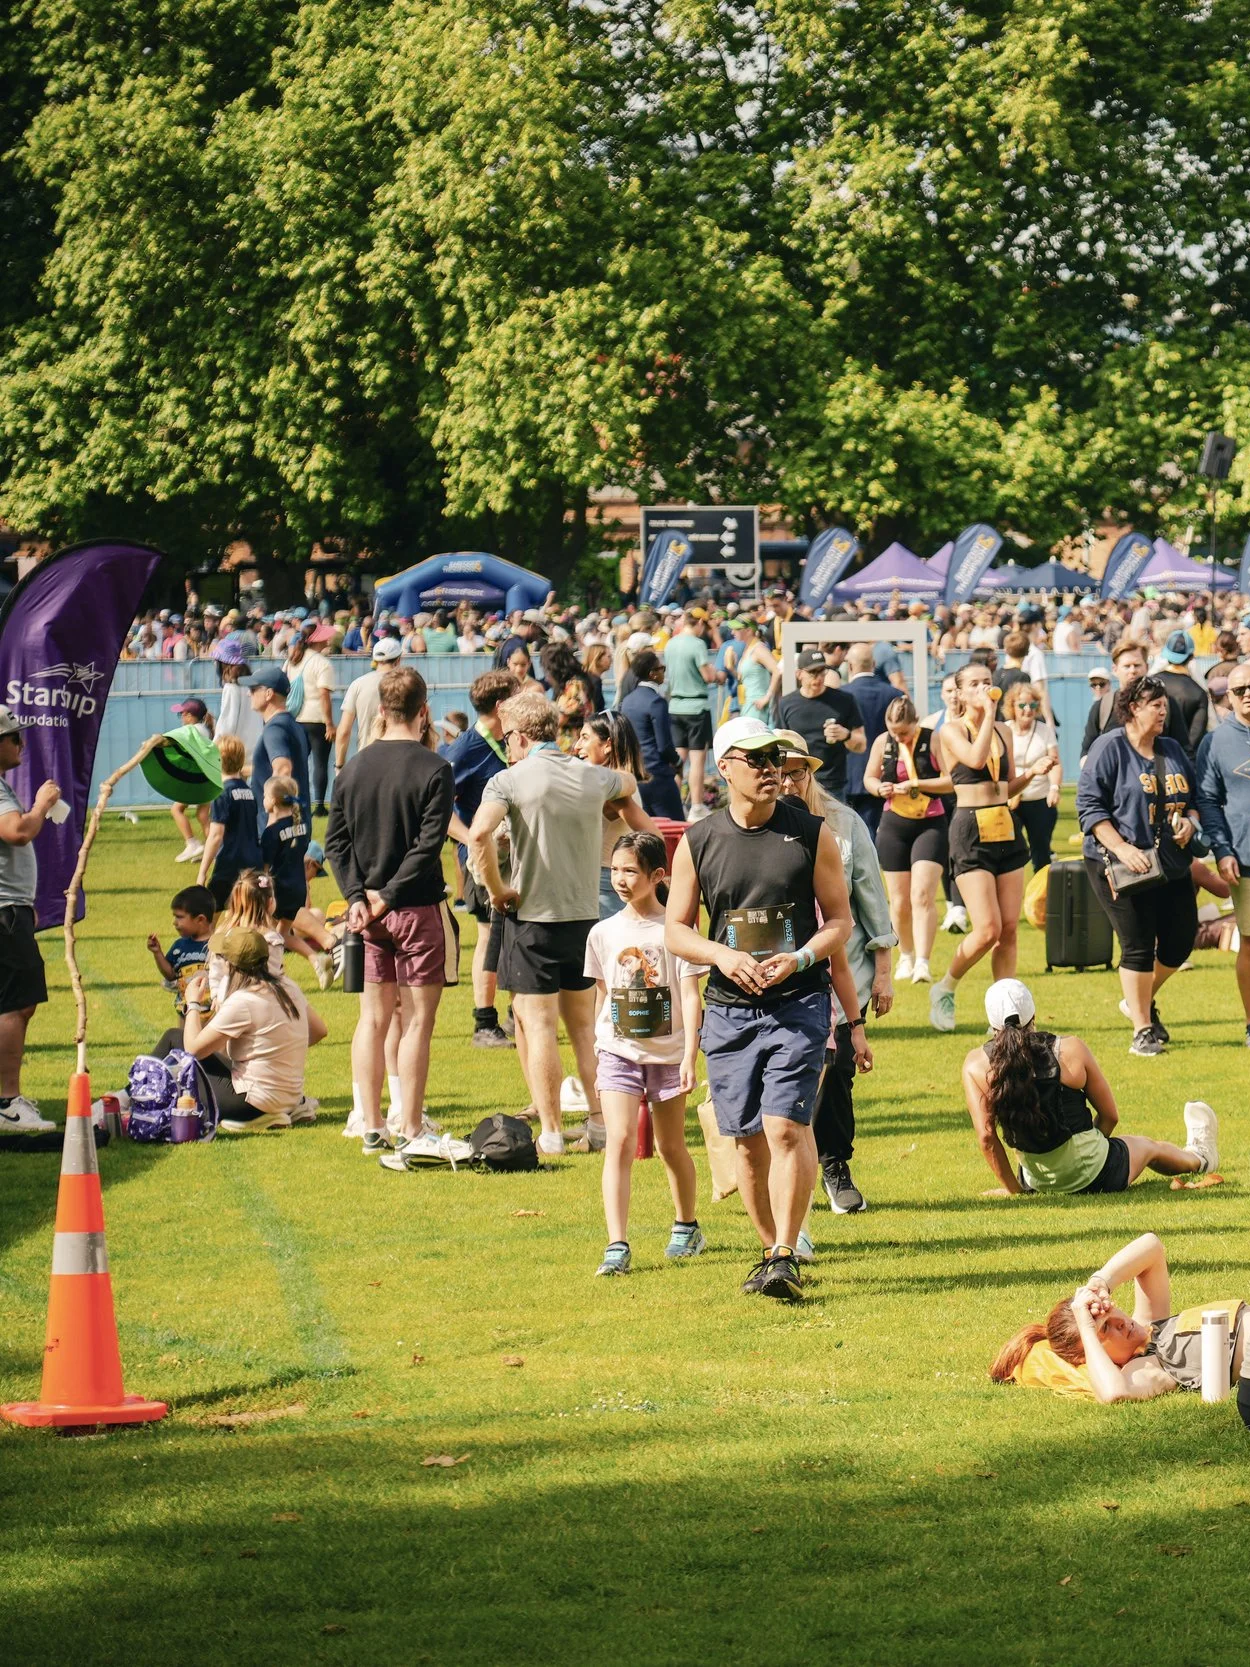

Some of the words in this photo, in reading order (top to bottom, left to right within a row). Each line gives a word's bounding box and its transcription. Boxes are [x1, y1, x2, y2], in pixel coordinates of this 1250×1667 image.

[14, 713, 69, 727] undatio
[1148, 802, 1187, 825] 175
[727, 925, 736, 948] 60528
[783, 919, 793, 942] 60528
